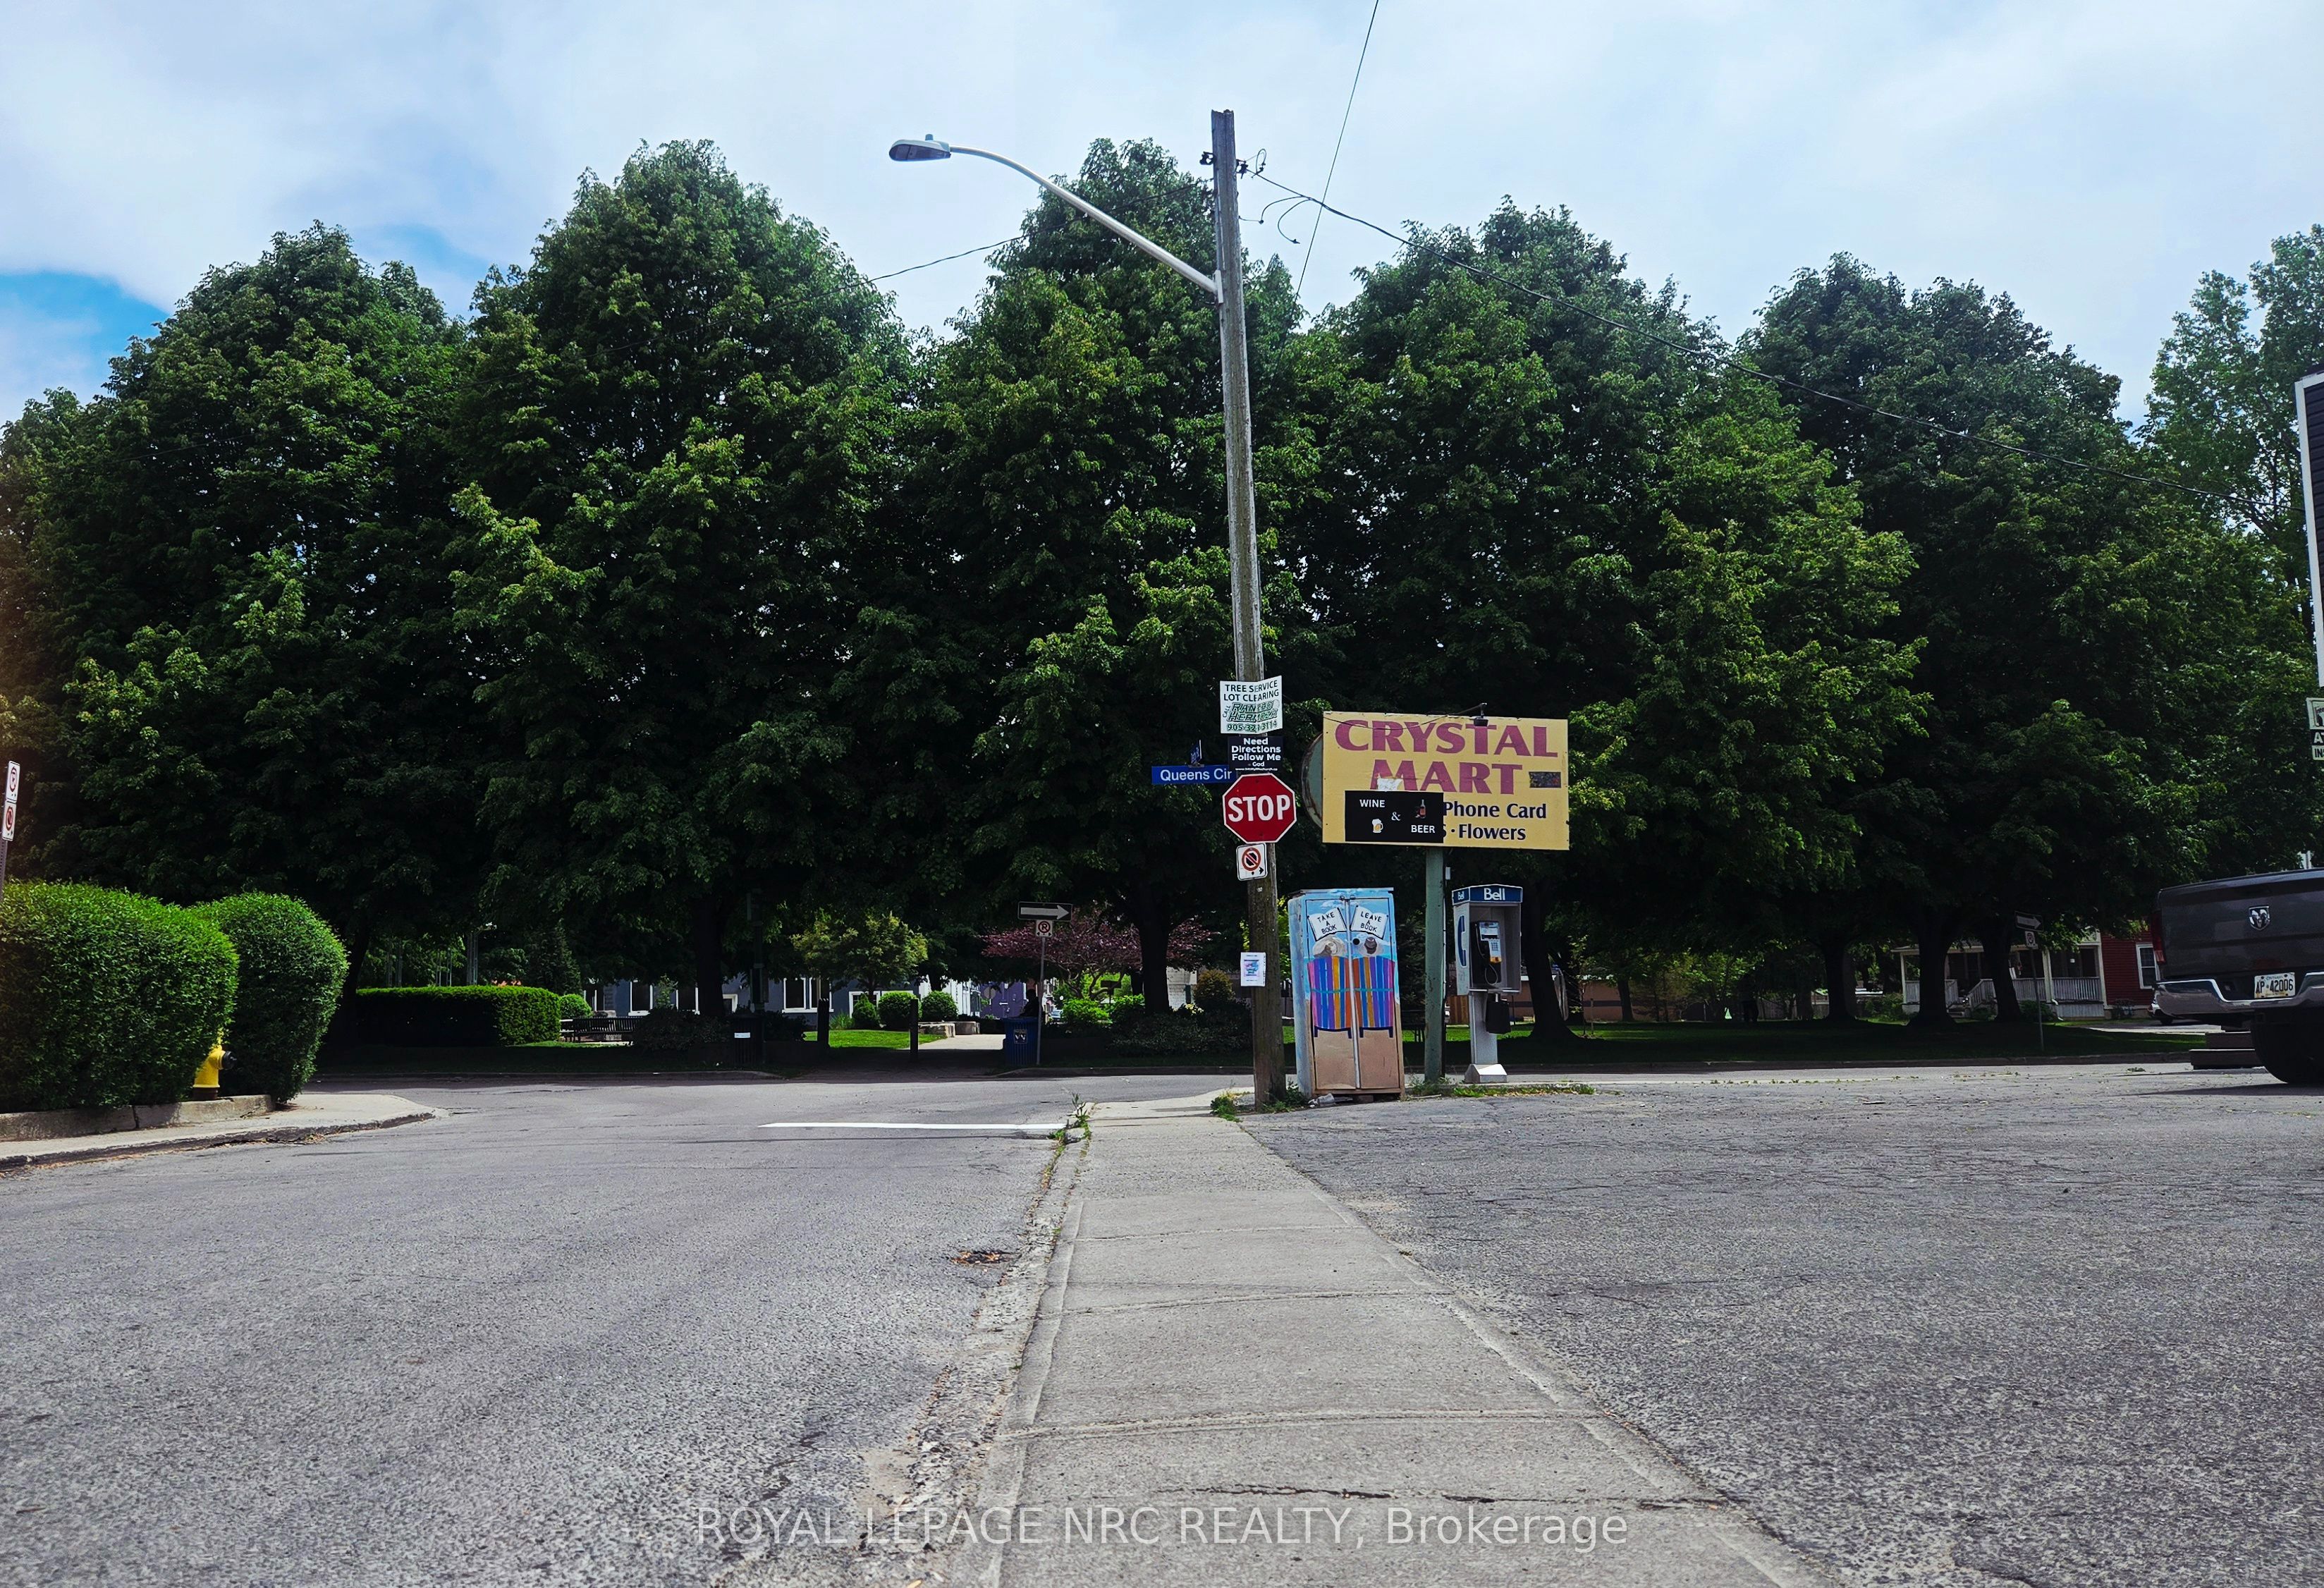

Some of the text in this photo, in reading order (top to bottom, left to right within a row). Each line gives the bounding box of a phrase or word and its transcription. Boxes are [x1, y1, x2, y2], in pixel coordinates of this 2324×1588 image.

[1225, 680, 1278, 693] TREE SERVICE
[1223, 689, 1280, 702] LOT CLEARING
[1222, 705, 1231, 718] CALL
[1335, 719, 1558, 757] CRYSTAL
[1231, 745, 1282, 753] Directions
[1160, 768, 1233, 781] Queens Cir
[1370, 759, 1523, 795] MART
[1228, 794, 1290, 822] STOP
[1359, 799, 1386, 808] WINE
[1442, 800, 1547, 819] Phone Card
[1391, 812, 1401, 822] &
[1411, 824, 1436, 833] BEER
[1459, 823, 1527, 841] Flowers
[1484, 888, 1505, 900] Bell
[1317, 911, 1335, 923] TAKE
[1360, 911, 1382, 922] LEAVE
[1321, 924, 1338, 934] BOOK
[1360, 922, 1378, 932] BOOK
